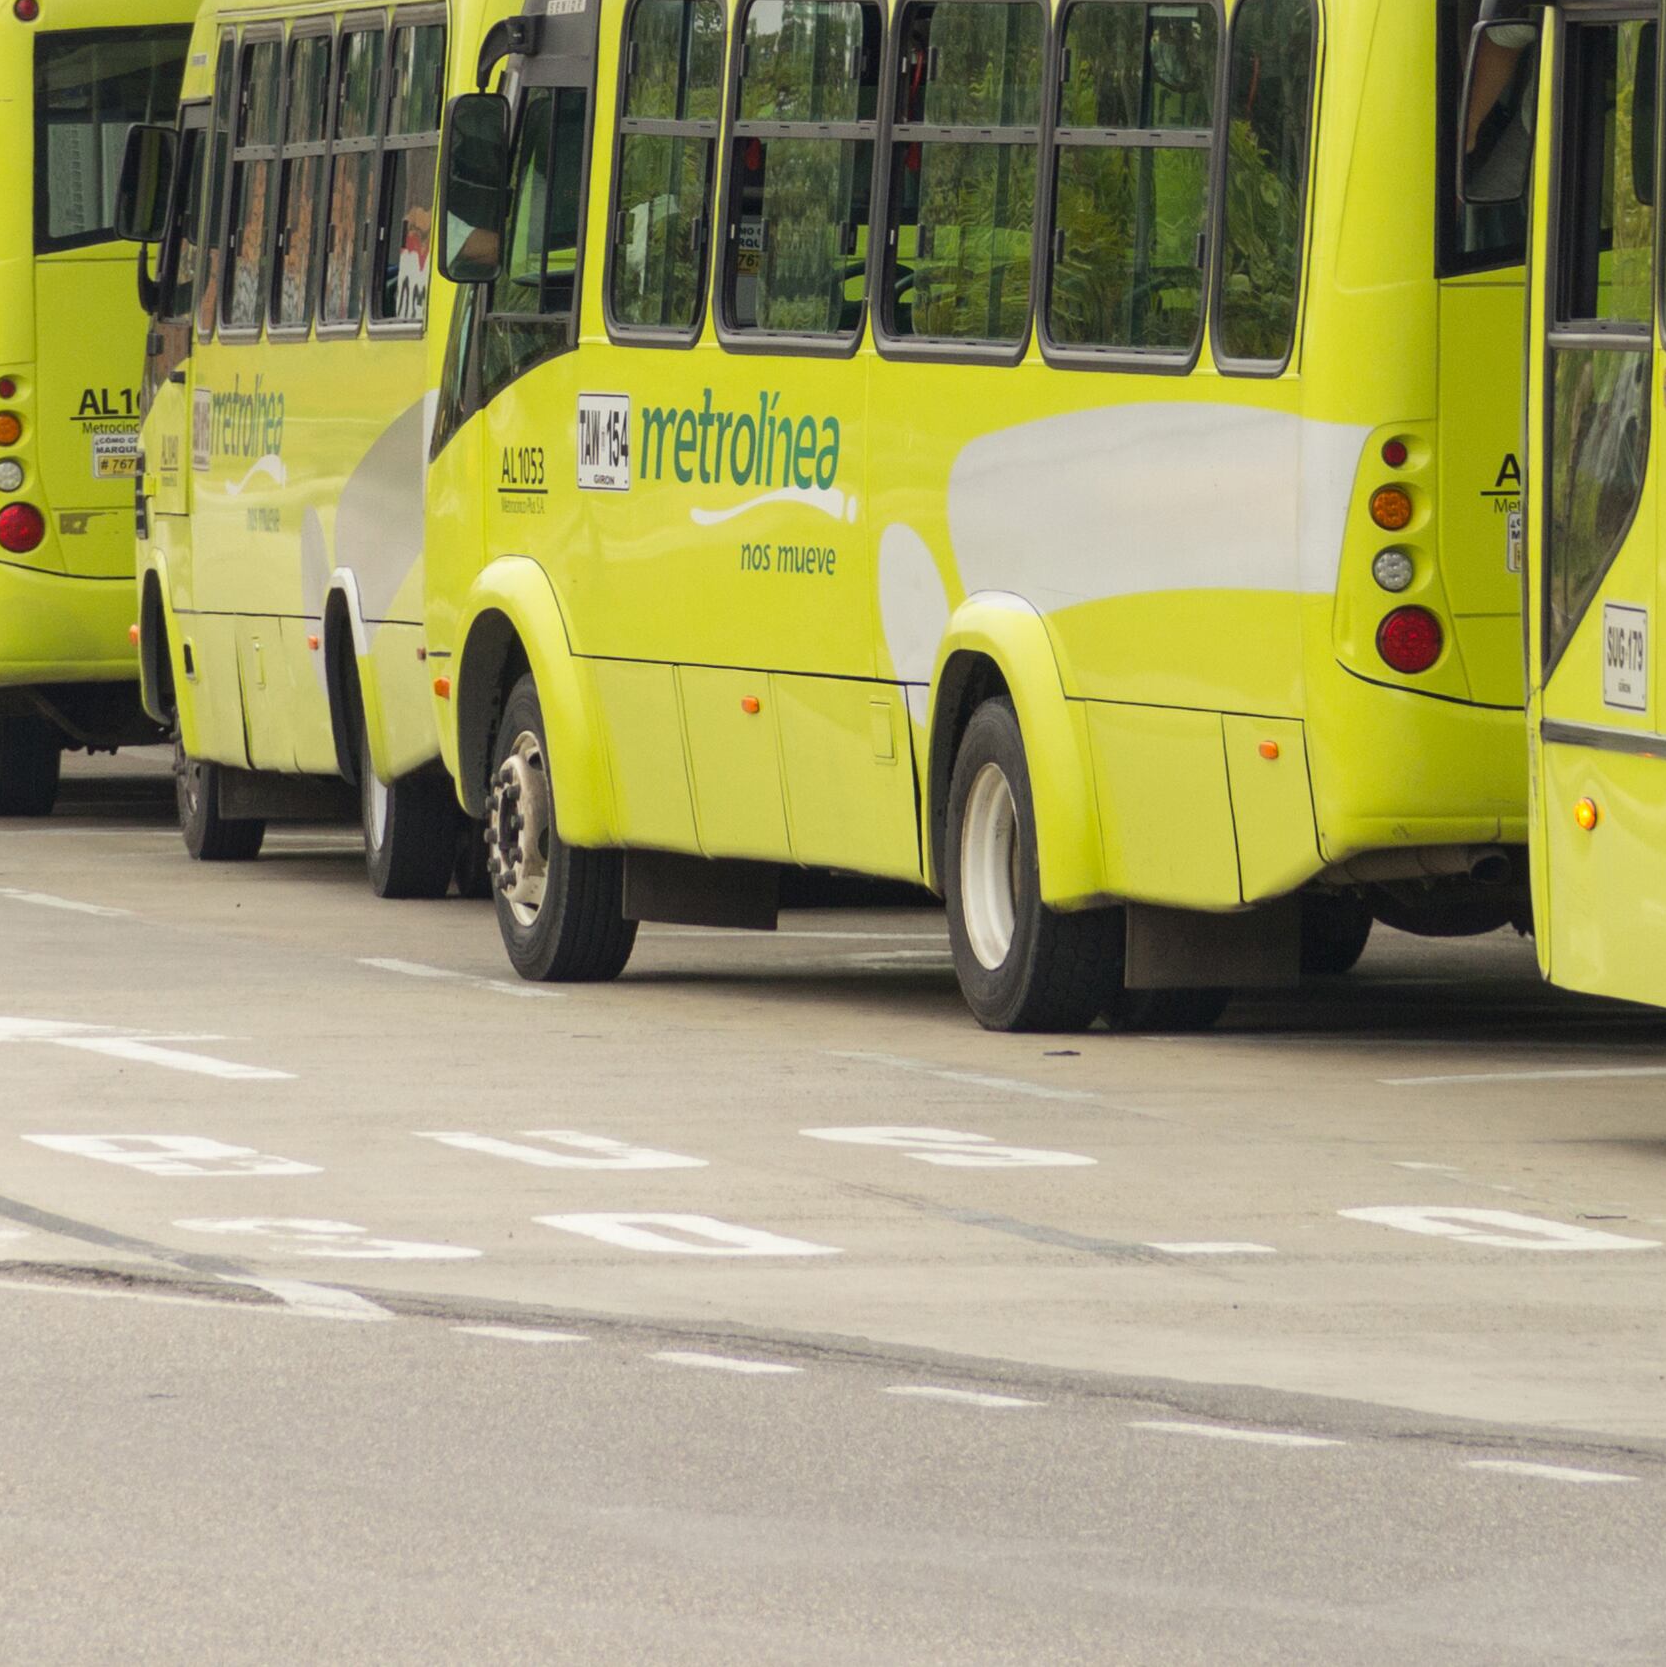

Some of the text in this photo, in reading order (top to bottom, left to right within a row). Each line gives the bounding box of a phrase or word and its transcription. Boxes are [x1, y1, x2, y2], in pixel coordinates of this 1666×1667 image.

[82, 422, 141, 435] Metrocinc
[640, 388, 840, 490] metrolínea
[112, 458, 135, 470] 767
[501, 447, 545, 485] AL1053
[741, 542, 836, 575] nos mueve
[20, 1126, 1100, 1177] BUS
